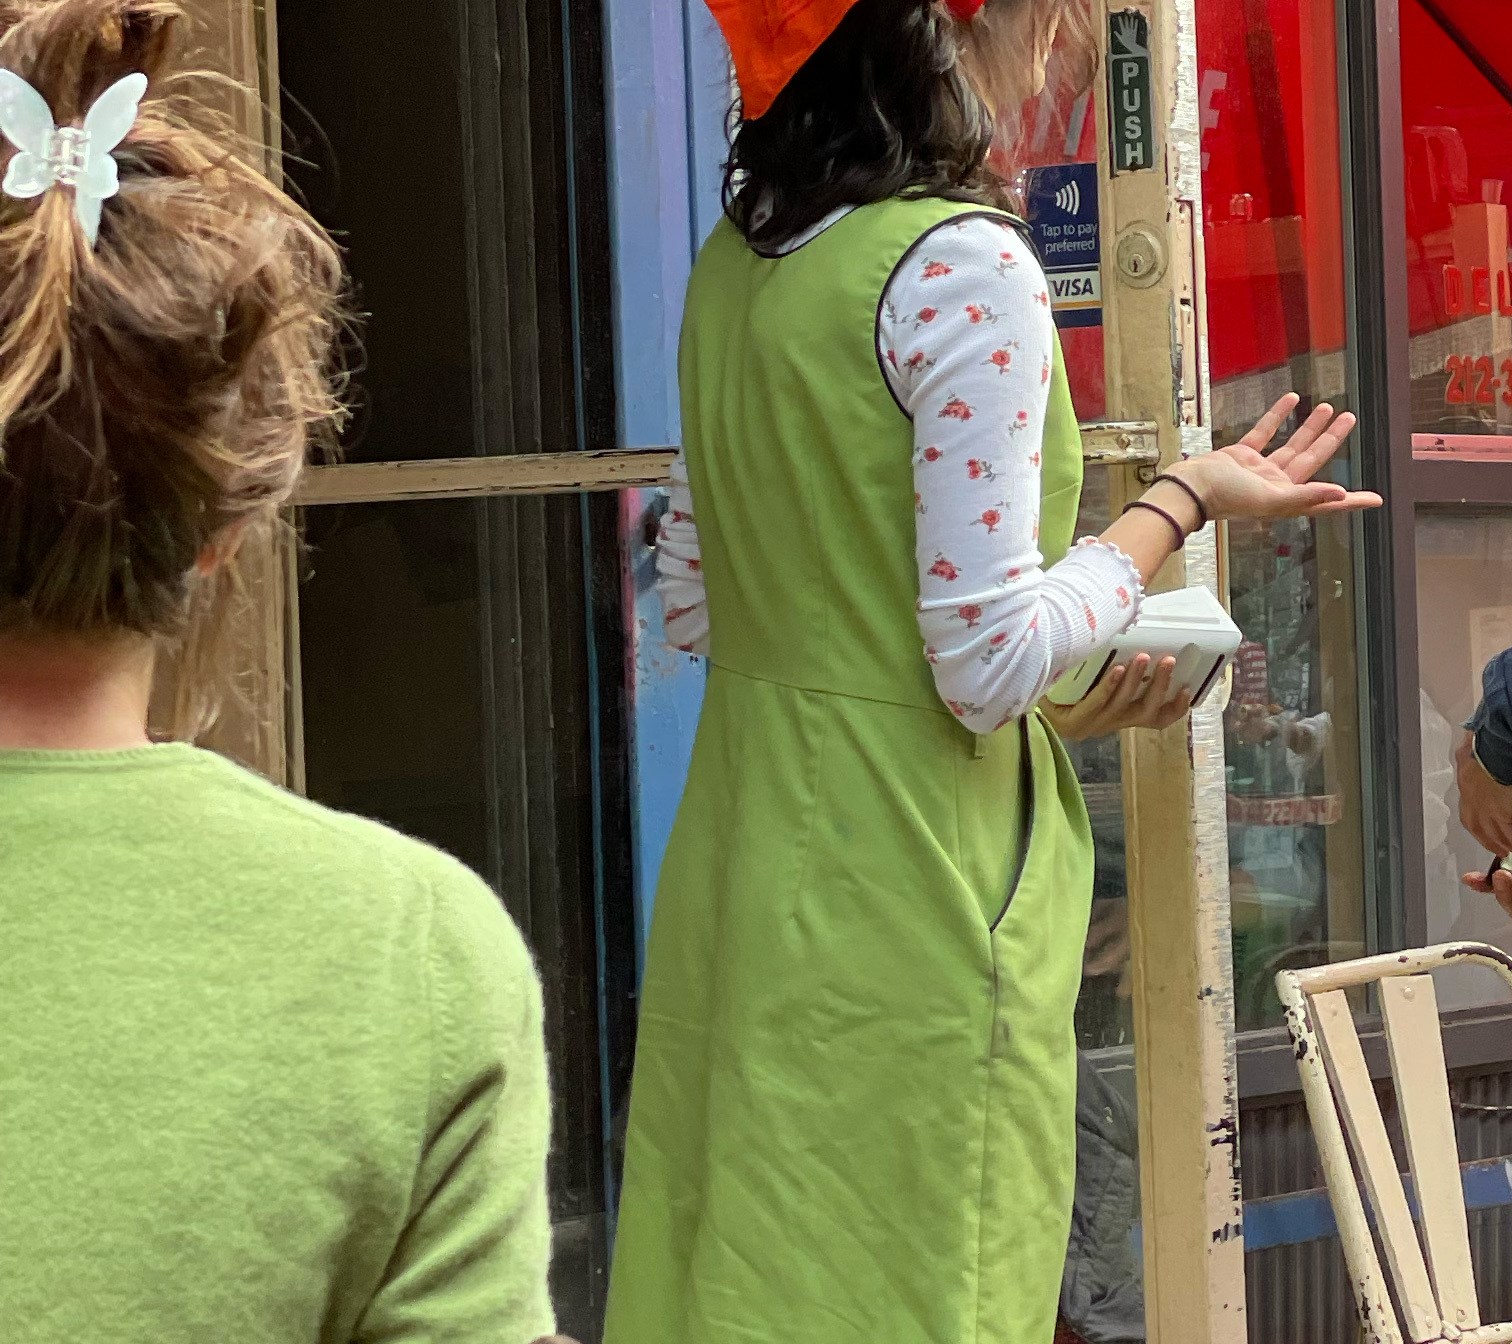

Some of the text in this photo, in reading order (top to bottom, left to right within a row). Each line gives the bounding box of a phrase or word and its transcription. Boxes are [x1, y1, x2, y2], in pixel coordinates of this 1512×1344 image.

[1122, 62, 1144, 166] PUSH
[1040, 222, 1098, 239] Tap to pay
[1045, 237, 1096, 256] preferred
[1049, 278, 1094, 297] VISA
